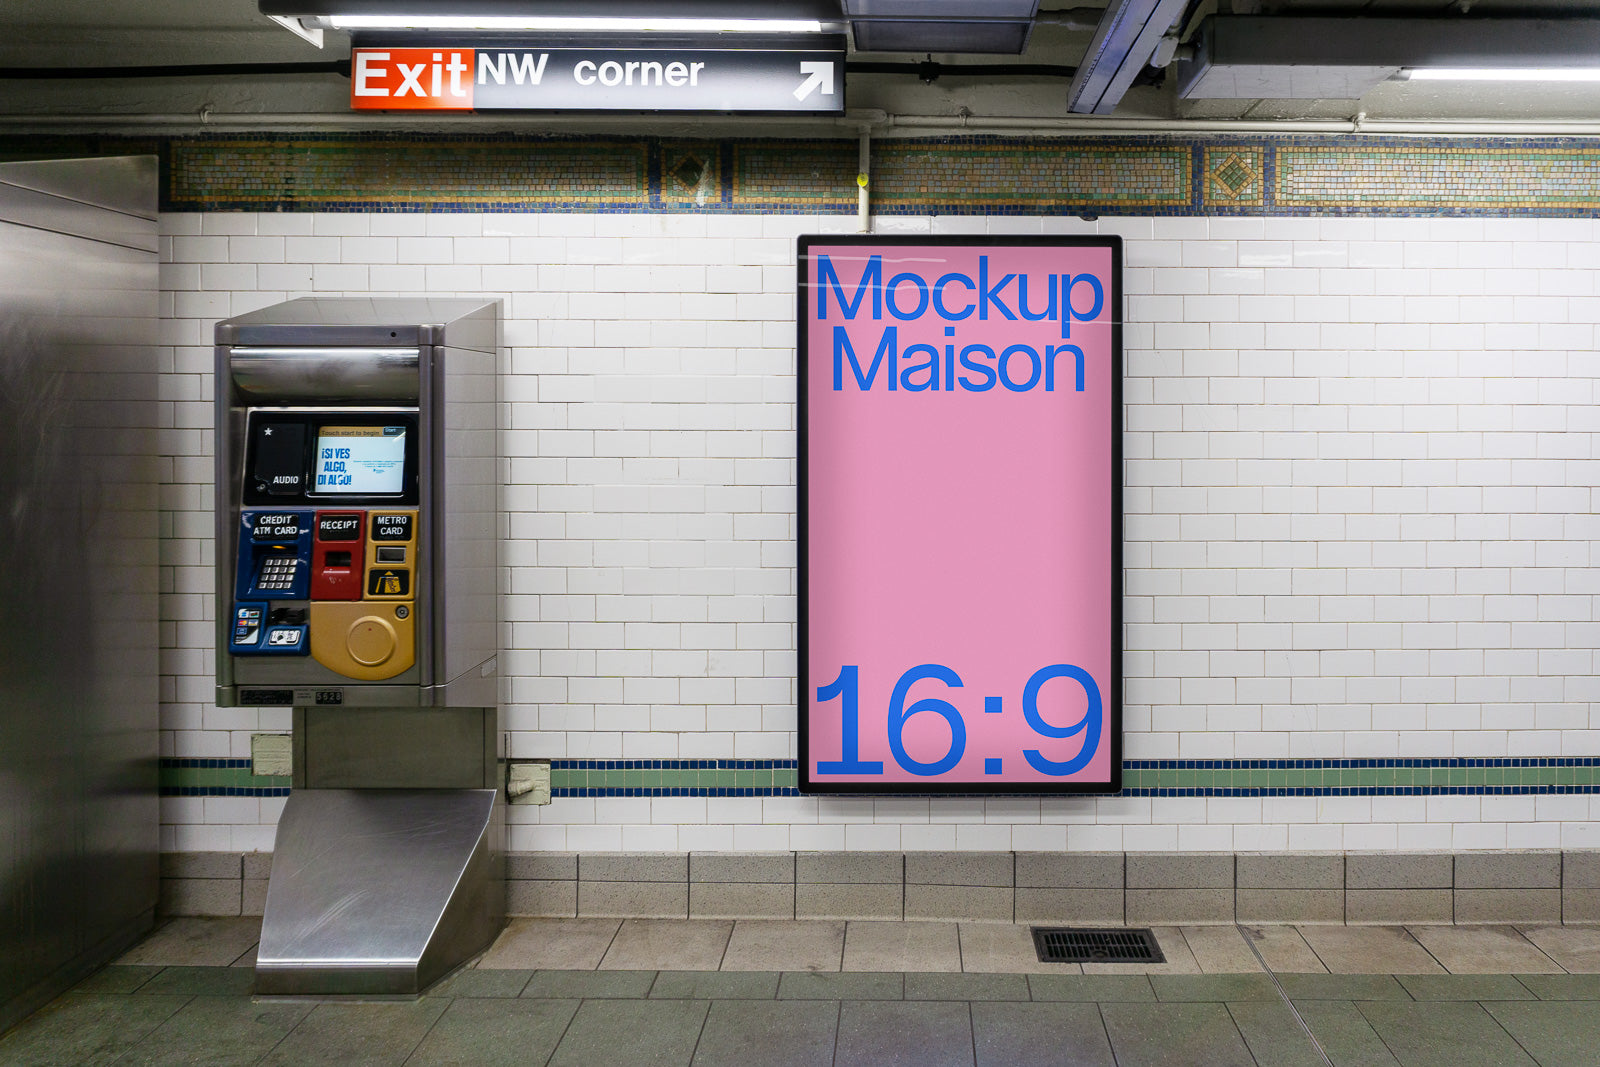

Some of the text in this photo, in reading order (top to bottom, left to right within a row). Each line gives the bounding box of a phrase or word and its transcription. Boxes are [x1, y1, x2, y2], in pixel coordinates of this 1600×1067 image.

[354, 52, 705, 98] Exit NW corner
[817, 254, 1104, 339] Mockup
[833, 326, 1085, 392] Maison
[335, 448, 351, 459] VES
[323, 461, 347, 474] ALGO,
[273, 475, 299, 484] AUDIO
[317, 474, 352, 485] DI ALGO!
[260, 515, 292, 524] CREDIT
[320, 520, 358, 530] RECEIPT
[377, 516, 407, 525] METRO
[253, 526, 298, 535] ATM CARD
[380, 527, 403, 535] CARD
[816, 663, 1103, 777] 16:9
